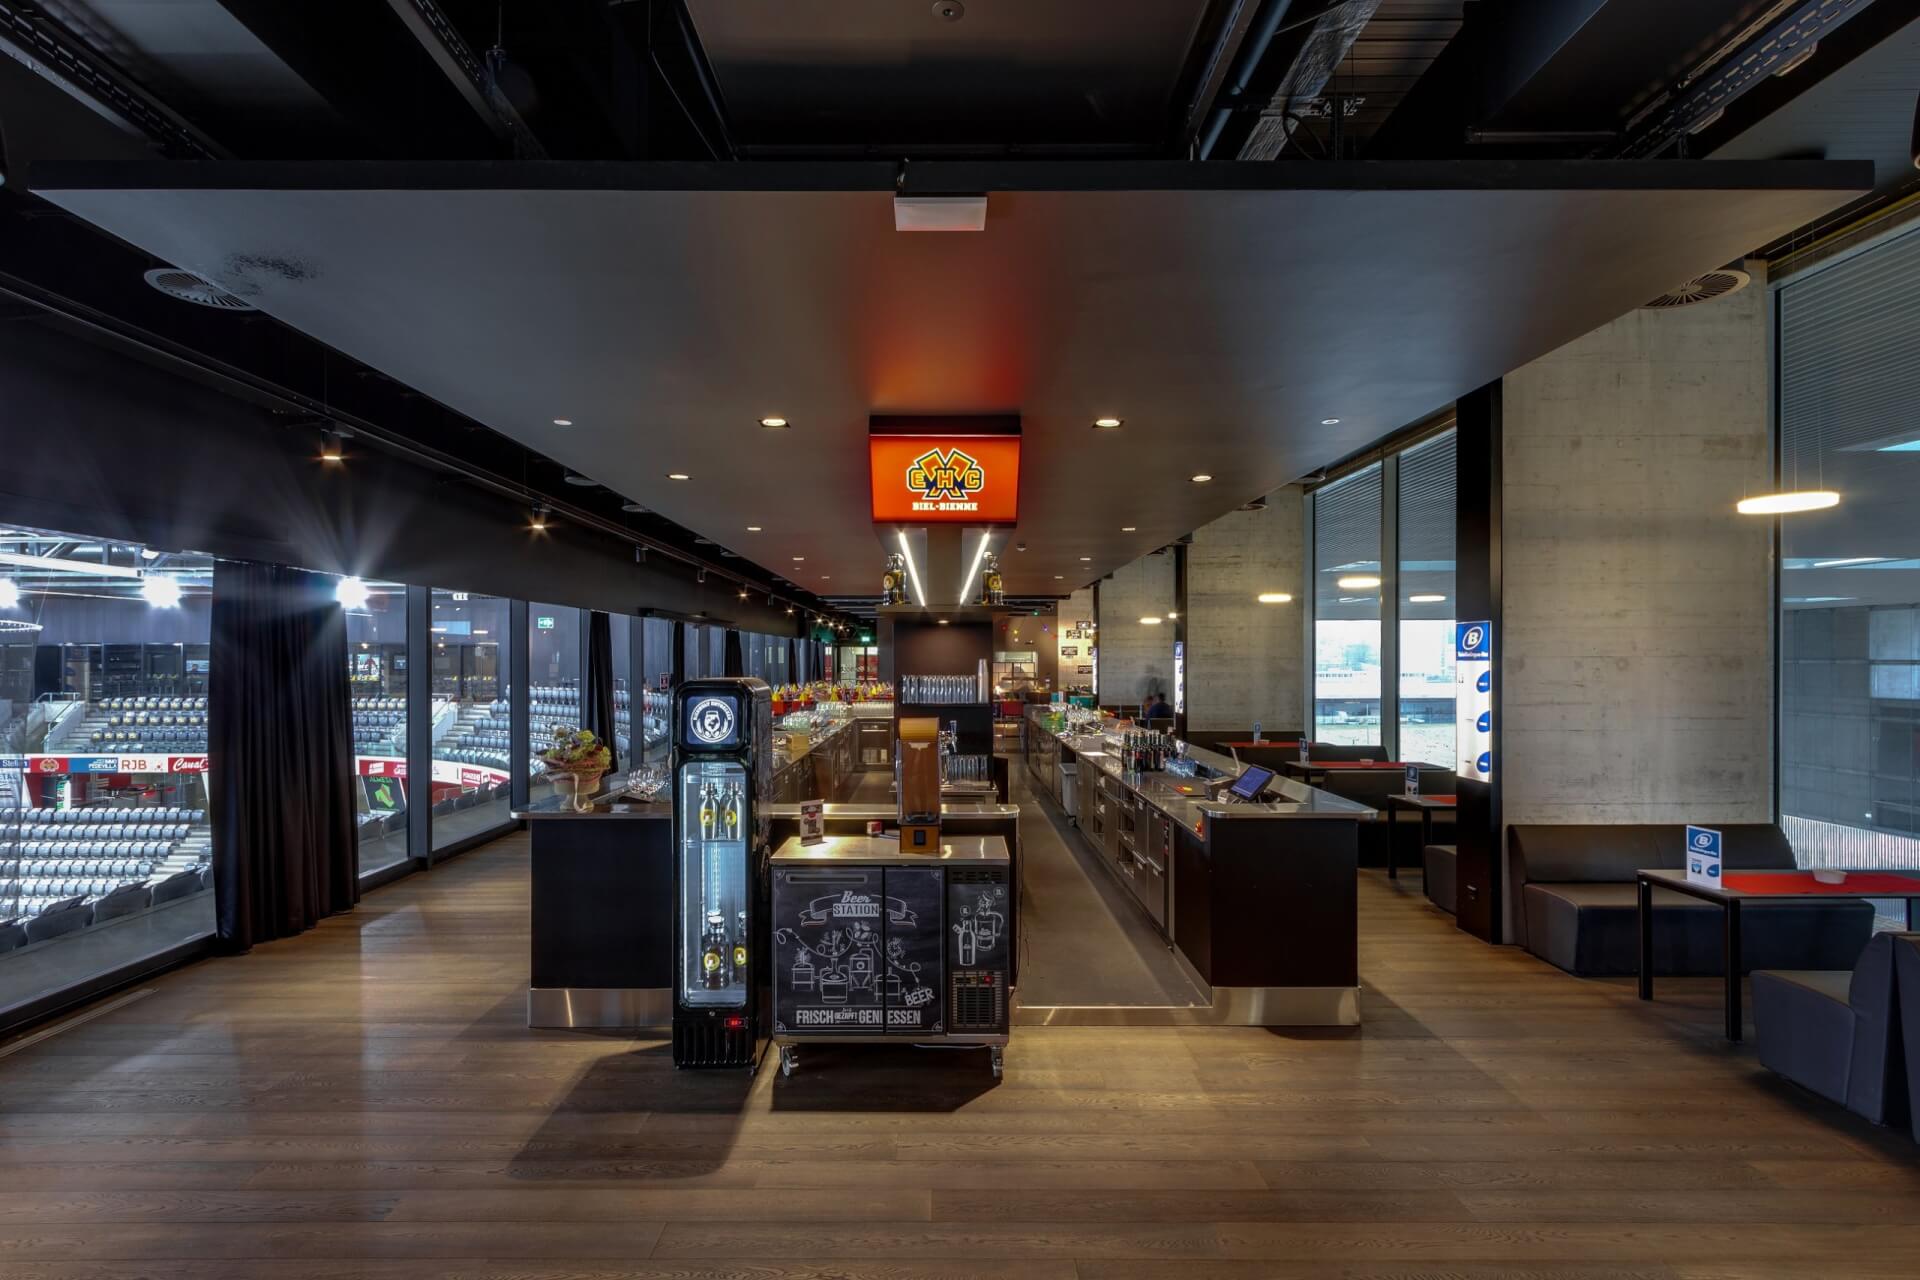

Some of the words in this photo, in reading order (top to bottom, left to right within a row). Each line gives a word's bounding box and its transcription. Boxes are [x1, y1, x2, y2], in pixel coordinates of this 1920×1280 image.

[1467, 631, 1479, 645] B
[121, 759, 147, 770] RJB
[172, 758, 205, 771] Canal
[841, 890, 872, 903] Beer
[833, 905, 879, 916] STATION
[904, 987, 935, 1006] BEER
[796, 1010, 834, 1024] FRISCH
